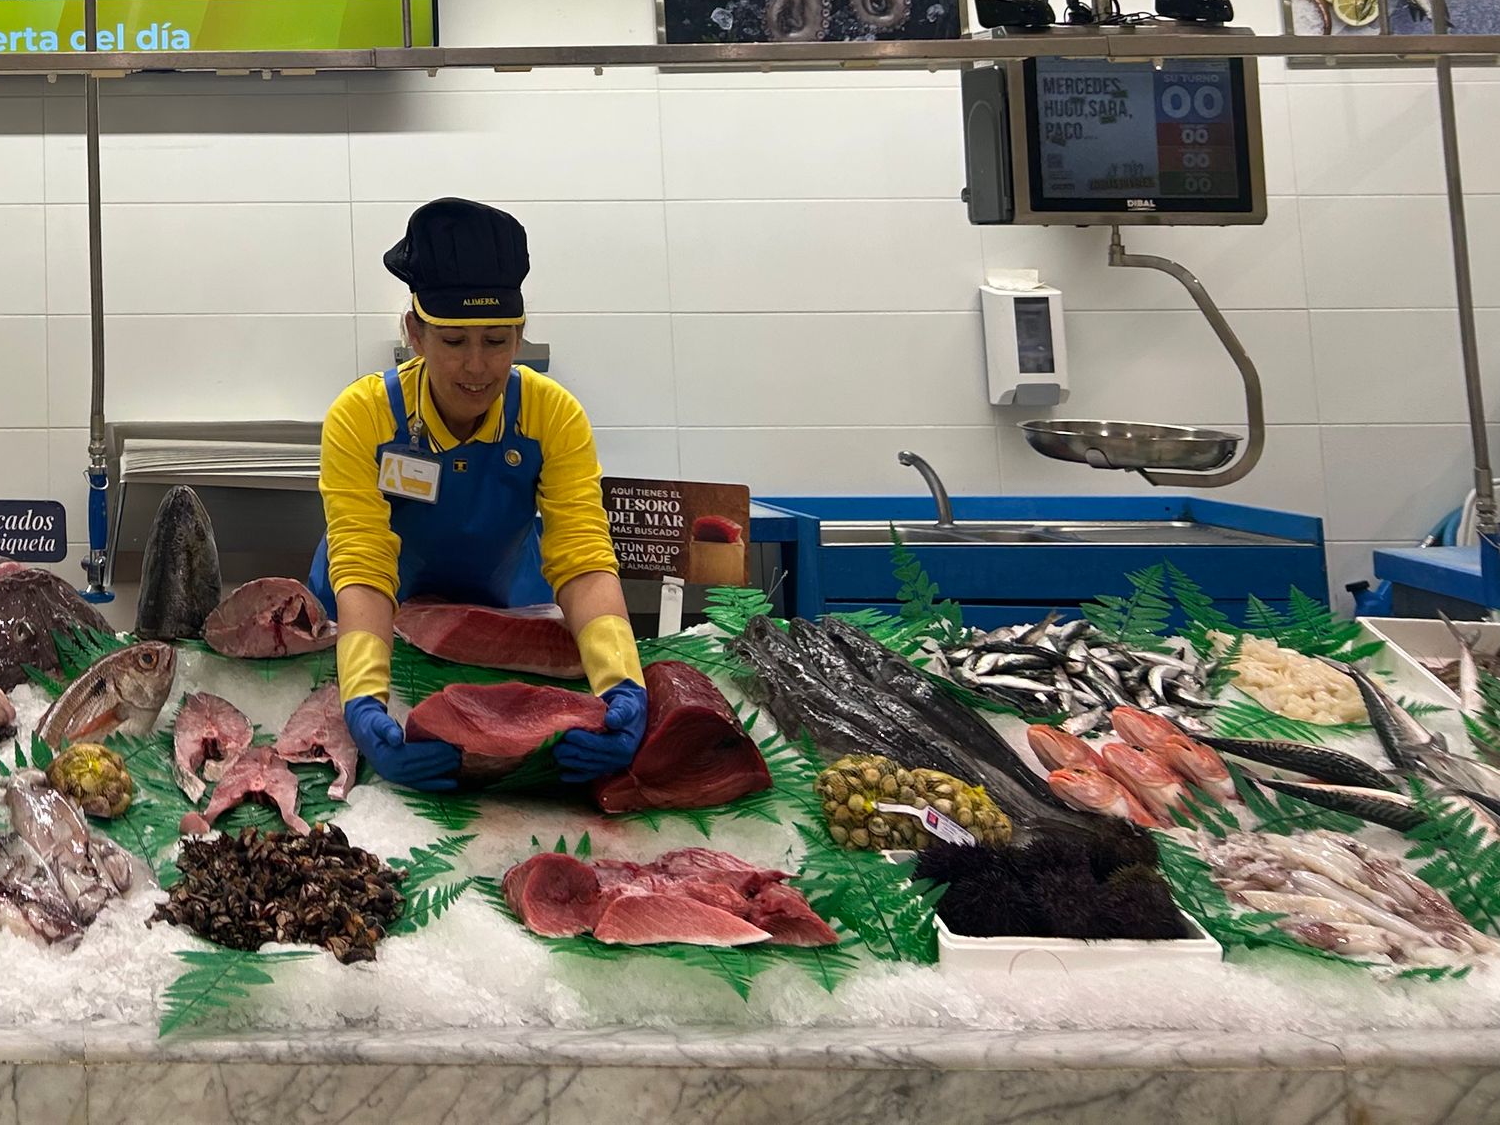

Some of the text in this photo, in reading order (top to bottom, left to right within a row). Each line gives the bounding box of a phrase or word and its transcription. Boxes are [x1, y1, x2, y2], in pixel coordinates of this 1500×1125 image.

[135, 22, 190, 51] día
[1164, 74, 1179, 83] SU
[1161, 85, 1224, 118] 00
[1181, 129, 1209, 144] 00
[1182, 153, 1210, 168] 00
[1185, 177, 1213, 192] 00
[1127, 199, 1156, 207] DIBAL
[463, 297, 500, 306] ALIMERKA
[611, 487, 681, 498] AQUÍ TIENES EL
[612, 497, 680, 513] TESORO
[609, 511, 684, 527] DEL MAR
[612, 525, 680, 537] MÁS BUSCADO
[614, 541, 680, 555] ATÚN ROJO
[621, 552, 671, 565] SALVAJE
[628, 563, 677, 573] ALMADRABA
